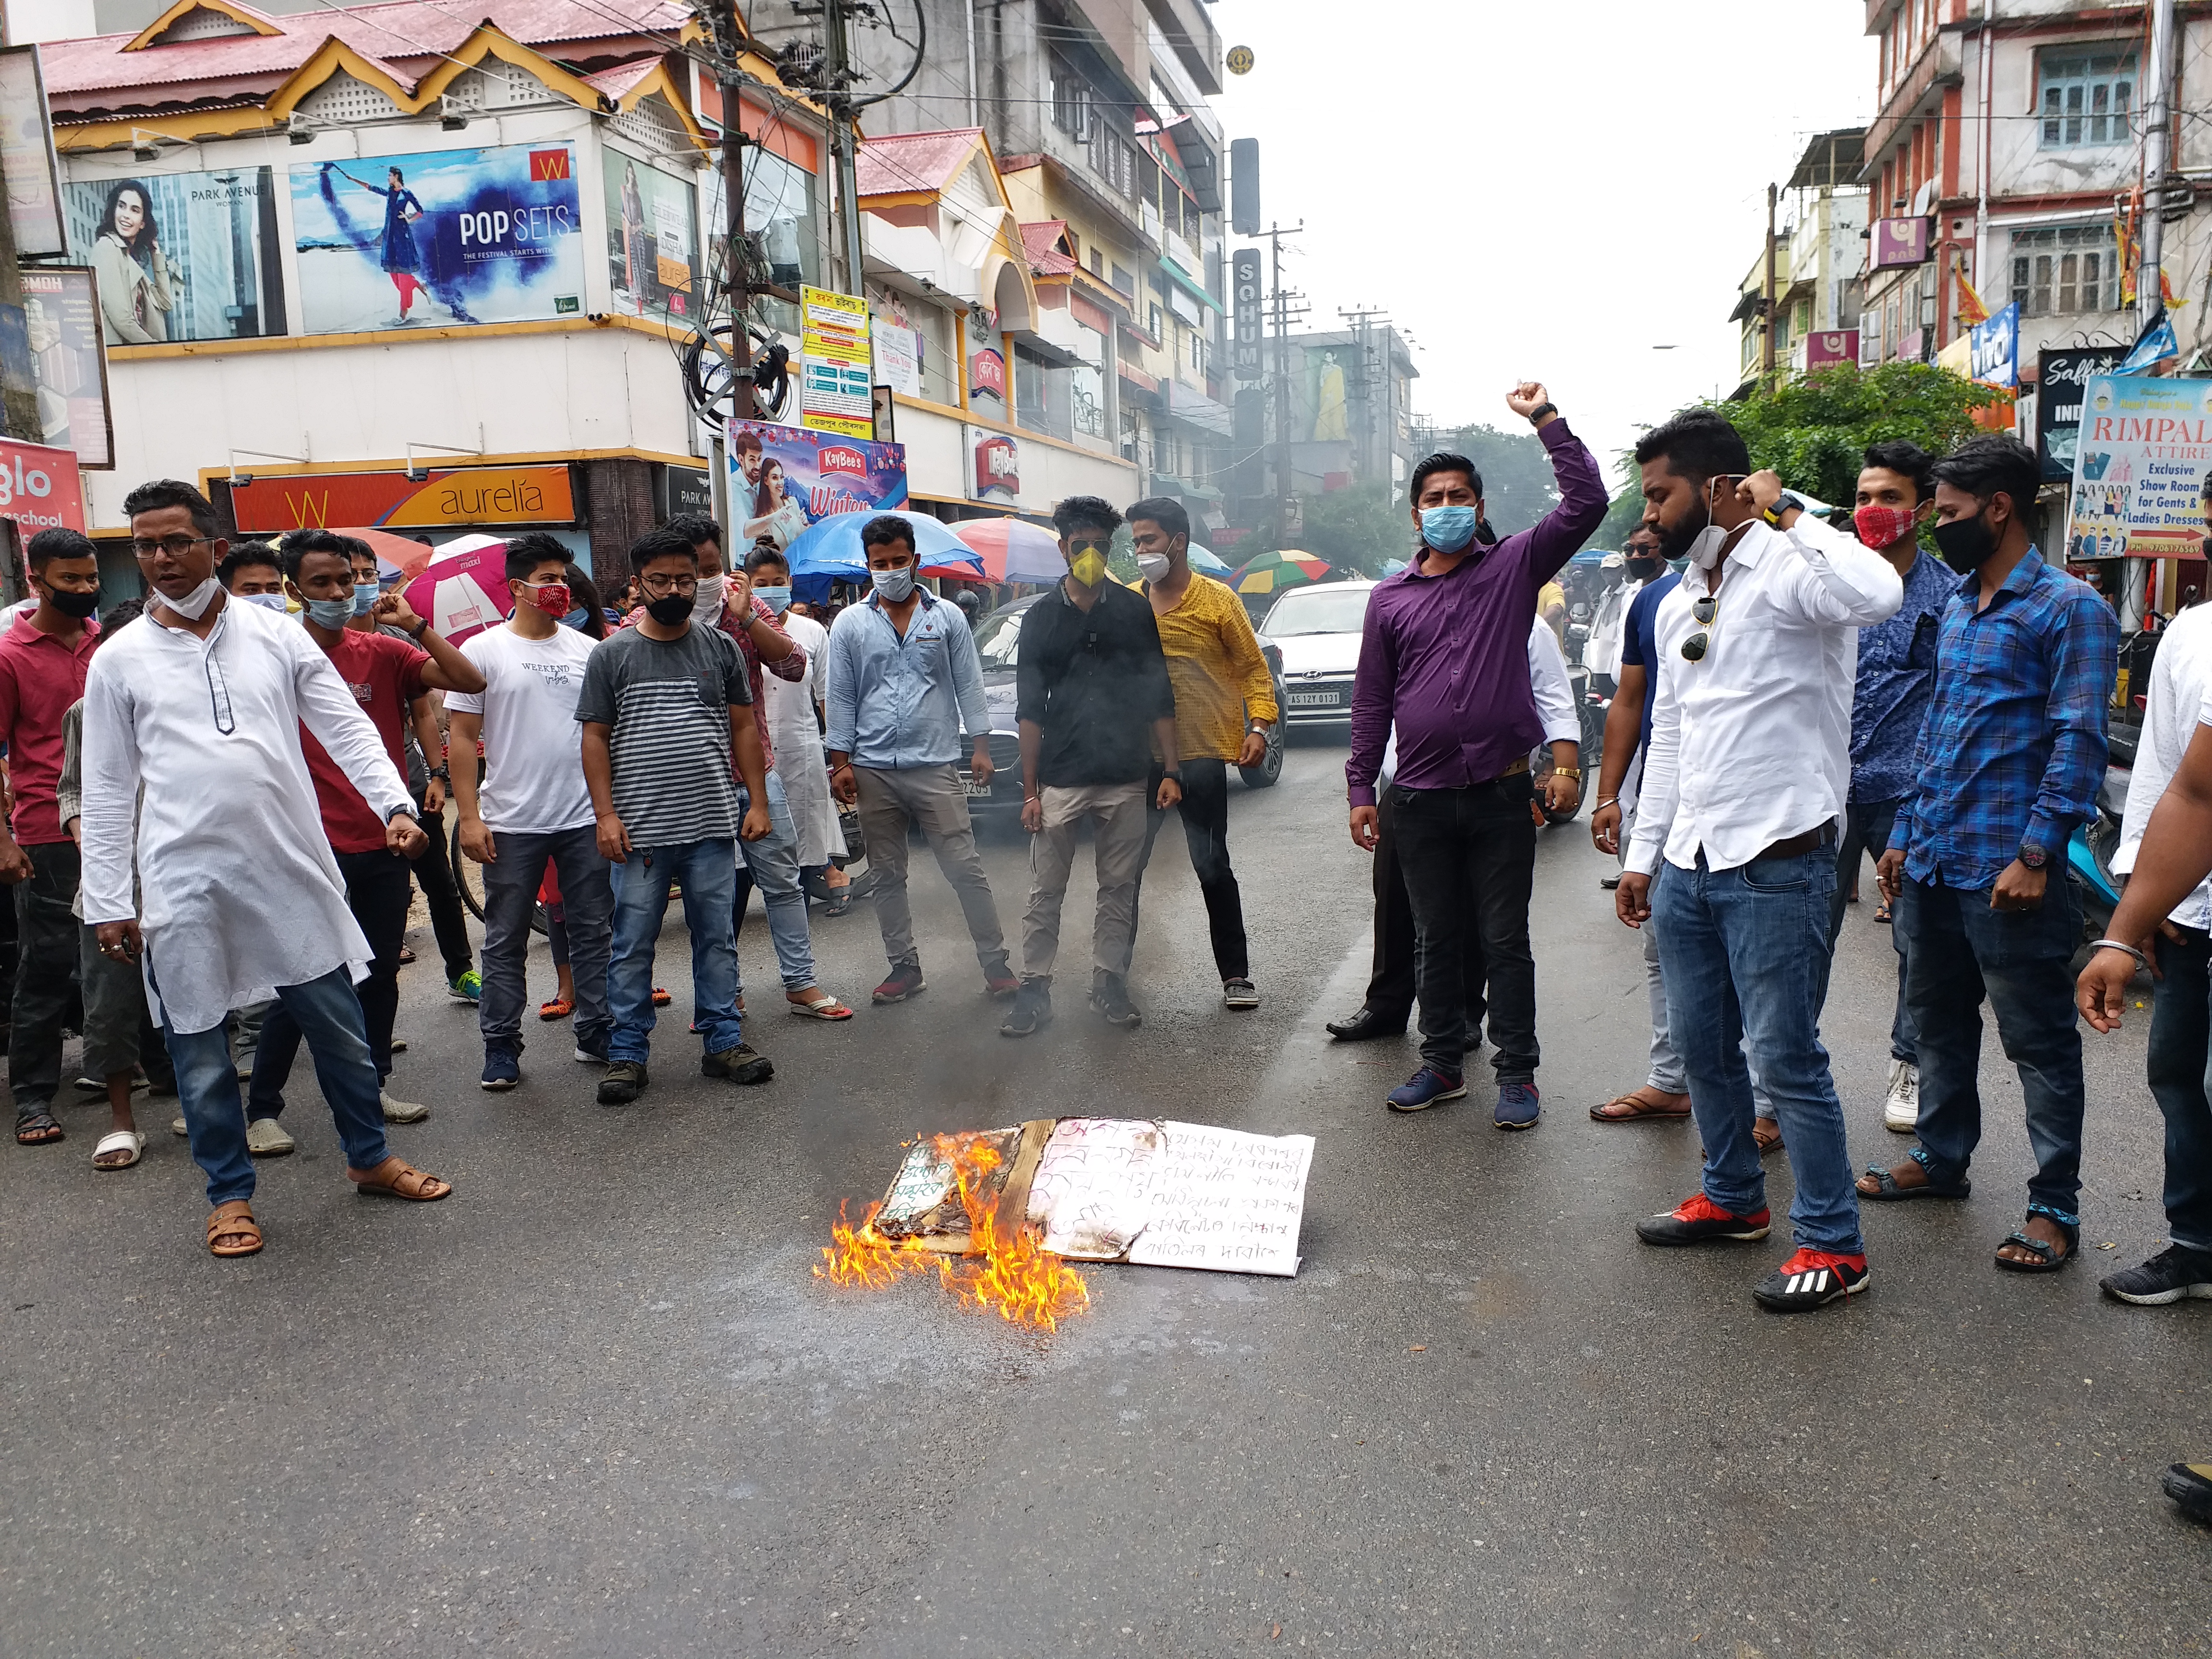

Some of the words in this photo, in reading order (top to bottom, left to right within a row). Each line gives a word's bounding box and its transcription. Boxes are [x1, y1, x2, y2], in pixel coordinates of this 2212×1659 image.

[539, 156, 565, 180] W
[192, 189, 220, 201] PARK
[224, 184, 264, 198] AVENUE
[459, 210, 509, 246] POP
[513, 205, 571, 241] SETS
[478, 250, 508, 259] FESTIVAL
[509, 248, 533, 257] STARTS
[535, 247, 553, 255] WITH
[1887, 249, 1917, 262] pnb
[881, 349, 900, 366] Thank
[901, 355, 912, 369] You
[2140, 445, 2210, 459] ATTIRE
[825, 450, 861, 469] KayBee's
[2149, 463, 2195, 475] Exclusive
[2140, 479, 2167, 491] Show
[2170, 481, 2200, 492] Room
[285, 490, 328, 529] W
[441, 478, 543, 514] aurelia
[681, 490, 701, 505] PARK
[2138, 495, 2153, 507] for
[2156, 496, 2186, 508] Gents
[2189, 497, 2197, 508] &
[2128, 512, 2160, 524] Ladies
[2164, 513, 2204, 525] Dresses
[2130, 543, 2142, 552] PH
[2149, 544, 2200, 553] 9706176569
[521, 662, 570, 673] WEEKEND
[1291, 695, 1301, 704] AS
[1303, 695, 1315, 704] 12Y
[1318, 694, 1338, 703] 0131
